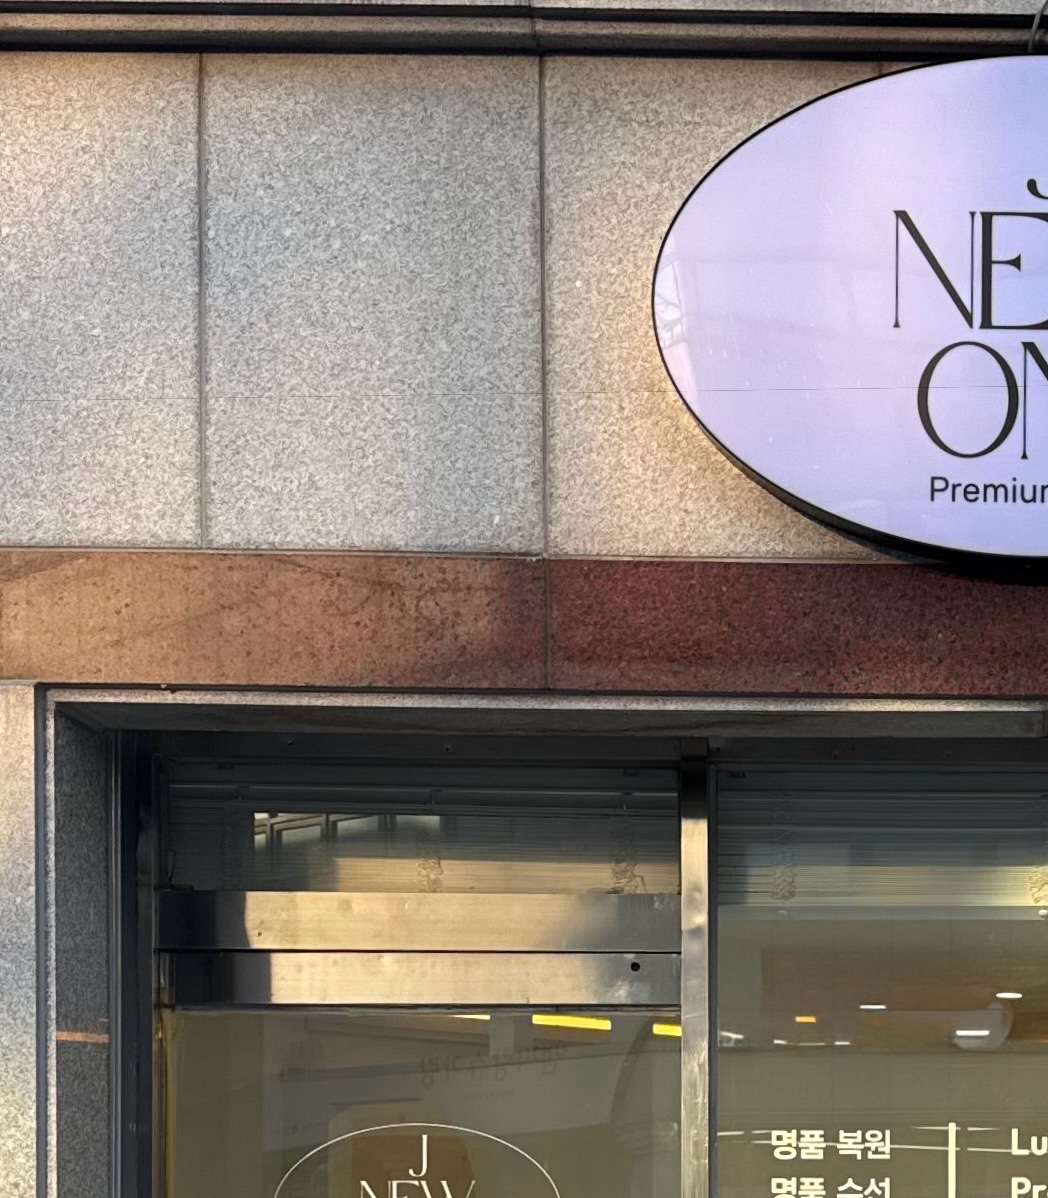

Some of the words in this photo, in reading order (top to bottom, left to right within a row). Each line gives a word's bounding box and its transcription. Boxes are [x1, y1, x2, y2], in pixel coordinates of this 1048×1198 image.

[408, 1134, 428, 1177] J
[771, 1129, 826, 1160] 명품
[836, 1129, 891, 1160] 복원
